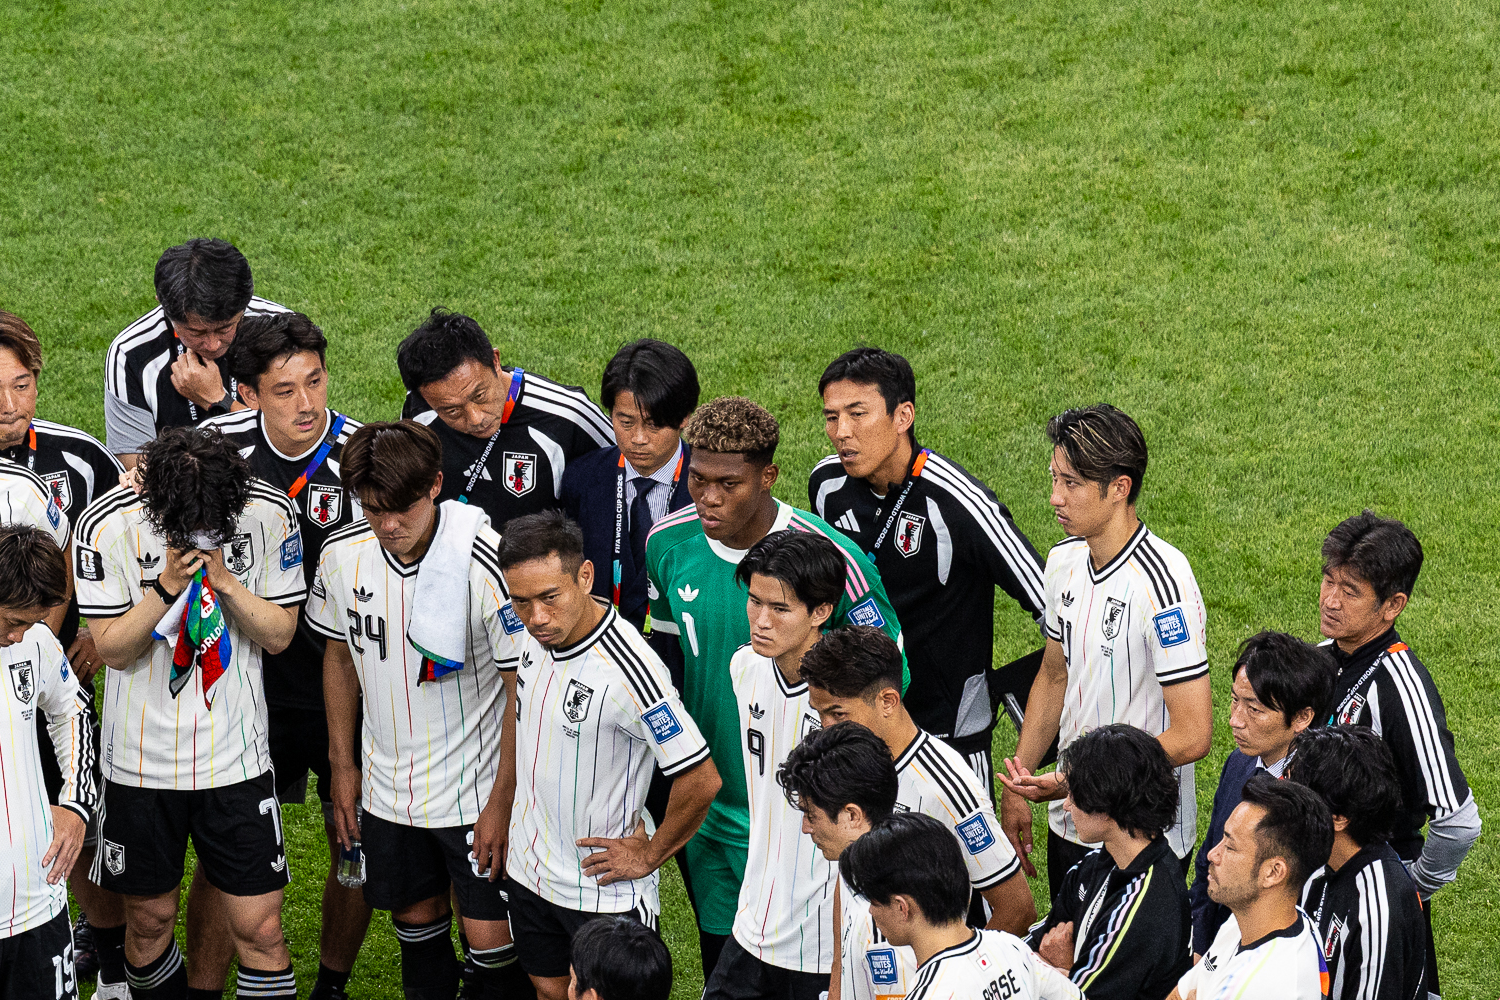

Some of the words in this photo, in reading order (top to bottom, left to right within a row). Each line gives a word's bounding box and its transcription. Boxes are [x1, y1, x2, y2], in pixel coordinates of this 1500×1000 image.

[189, 405, 197, 420] FIFA
[479, 439, 493, 462] WORLD
[473, 460, 484, 473] CUP
[464, 471, 478, 492] 2026
[890, 493, 906, 516] WORLD
[884, 514, 894, 528] CUP
[873, 526, 888, 549] 2026
[855, 609, 875, 620] UNITES
[1158, 614, 1179, 624] FOOTBALL
[681, 610, 698, 656] 1
[1160, 621, 1180, 631] UNITES
[347, 608, 386, 662] 24
[1356, 664, 1375, 686] WORLD
[651, 714, 670, 728] UNITES
[747, 727, 765, 775] 9
[962, 820, 980, 832] FOOTBALL
[964, 826, 983, 839] UNITES
[872, 960, 891, 969] UNITES
[51, 945, 78, 1000] 15
